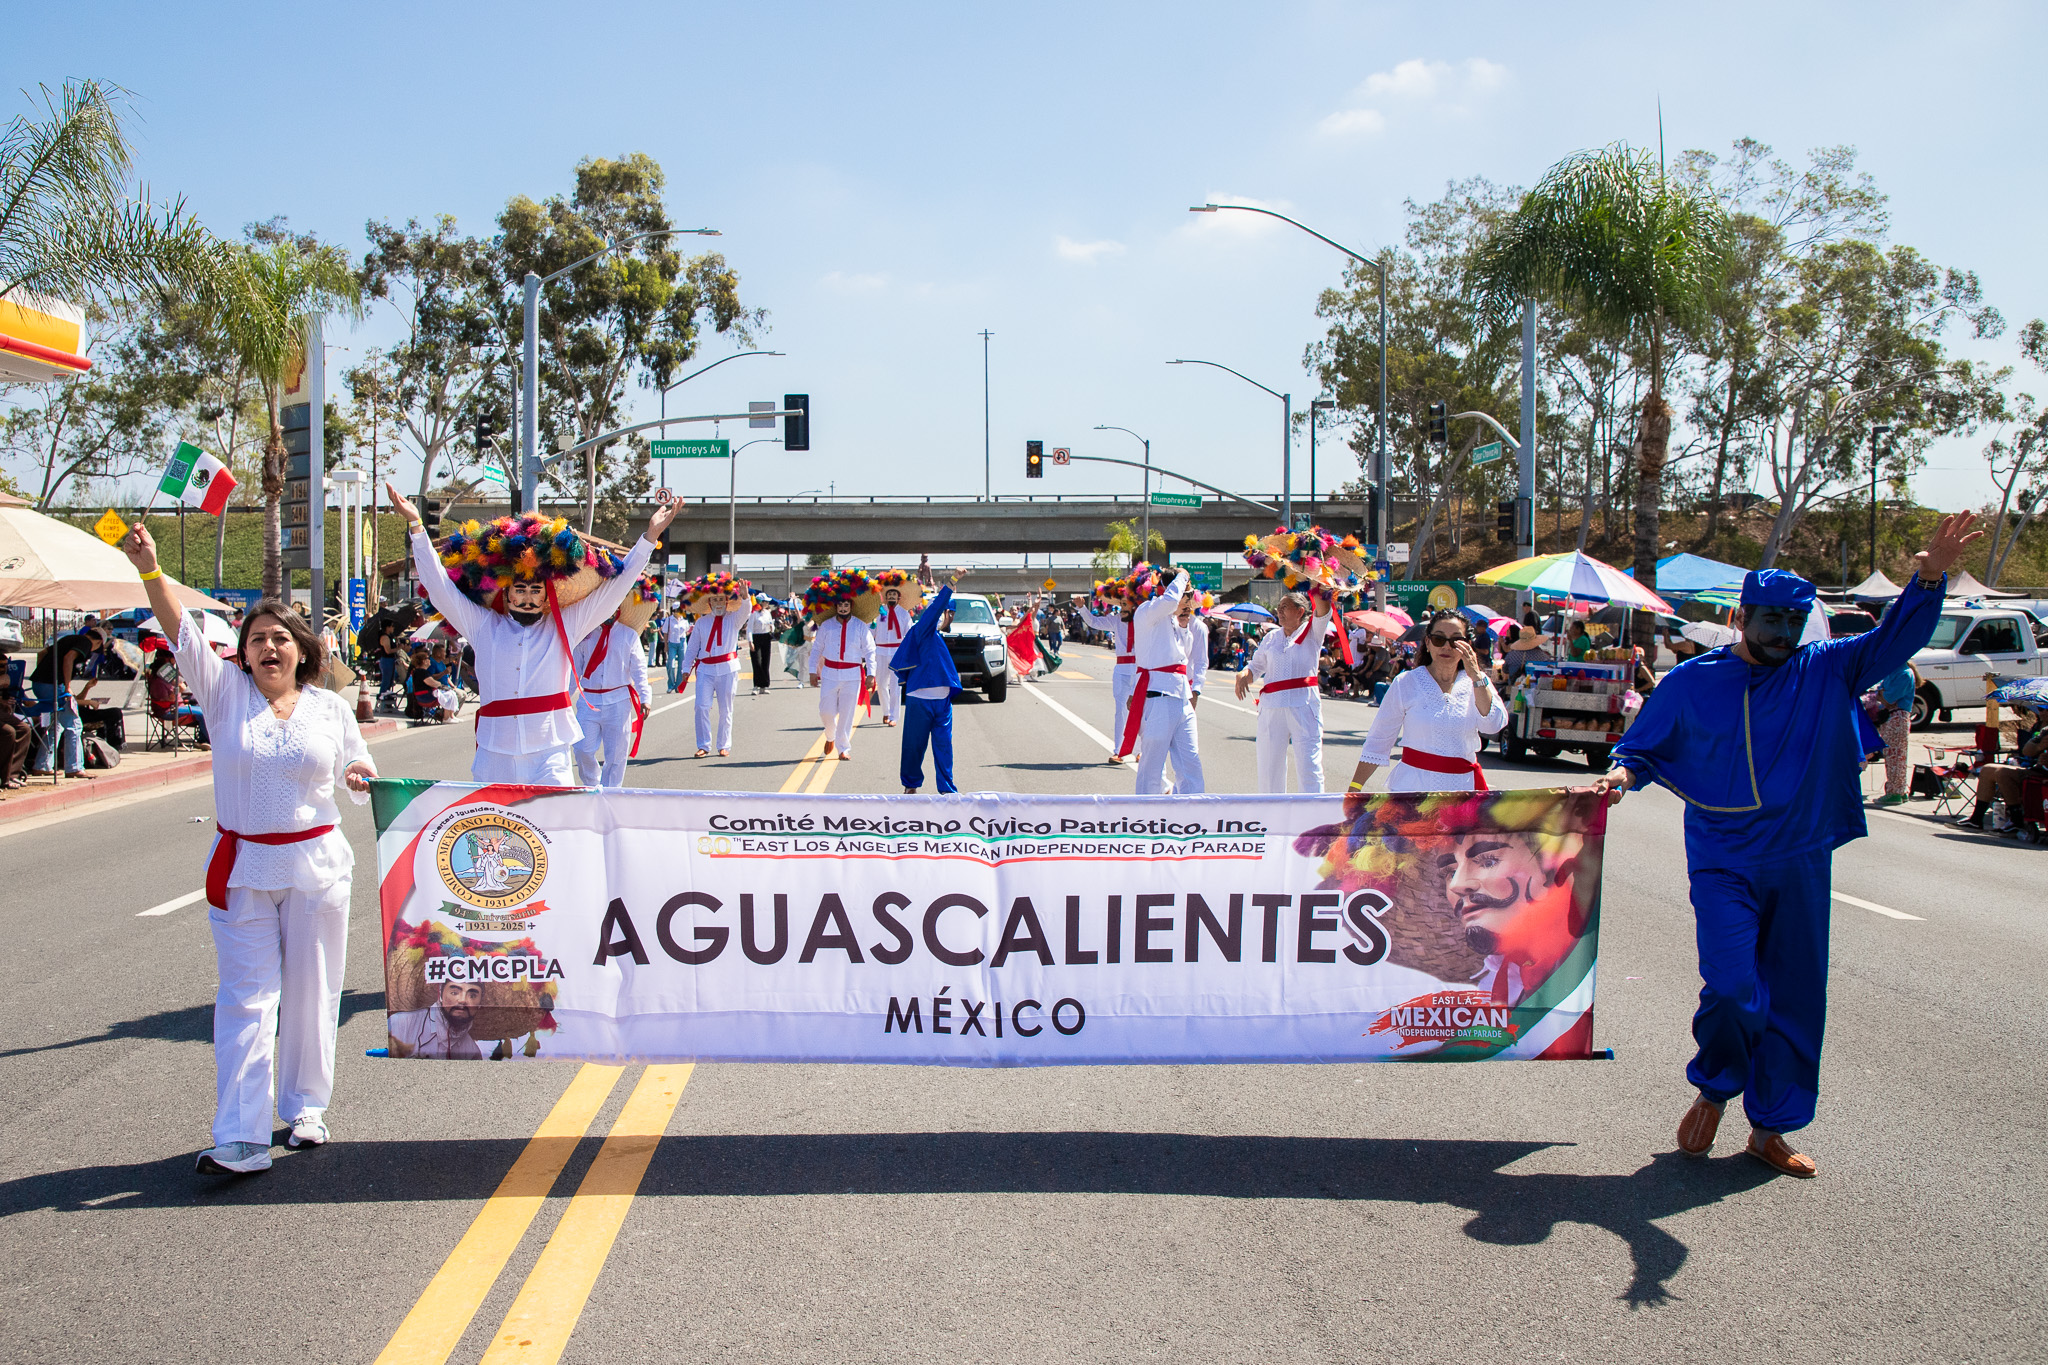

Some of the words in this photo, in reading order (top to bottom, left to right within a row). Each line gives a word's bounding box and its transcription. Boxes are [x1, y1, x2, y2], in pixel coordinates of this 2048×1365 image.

[654, 444, 708, 456] Humphreys
[709, 443, 721, 454] Av
[1153, 495, 1187, 505] Humphreys
[1189, 497, 1196, 505] Av
[1397, 584, 1429, 592] SCHOOL
[428, 813, 455, 843] Libertad
[455, 806, 495, 817] Igualdad
[507, 811, 552, 845] Fraternidad
[439, 817, 483, 856] MEXICANO
[493, 816, 533, 839] CIVICO
[708, 813, 815, 831] Comité
[823, 815, 961, 834] Mexicano
[969, 816, 1052, 837] Cívico
[1060, 816, 1207, 835] Patriótico,
[1216, 819, 1267, 833] Inc.
[742, 839, 789, 852] EAST
[794, 839, 830, 852] LOS
[835, 837, 918, 854] ÁNGELES
[924, 840, 1001, 860] MEXICAN
[1006, 843, 1146, 857] INDEPENDENCE
[1151, 842, 1187, 855] DAY
[1192, 841, 1266, 853] PARADE
[441, 864, 473, 901] COMITE
[516, 844, 546, 900] PATRIOTICO
[476, 908, 537, 921] Aniversario
[484, 899, 507, 908] 1931
[469, 922, 490, 930] 1931
[501, 922, 524, 930] 2025
[592, 890, 1389, 968] AGUASCALIENTES
[428, 958, 565, 981] #CMCPLA
[883, 985, 1087, 1039] MÉXICO
[1432, 996, 1455, 1005] EAST
[1390, 1006, 1508, 1028] MEXICAN
[1397, 1028, 1455, 1037] INDEPENDENCE
[1457, 1029, 1471, 1037] DAY
[1473, 1029, 1502, 1038] PARADE
